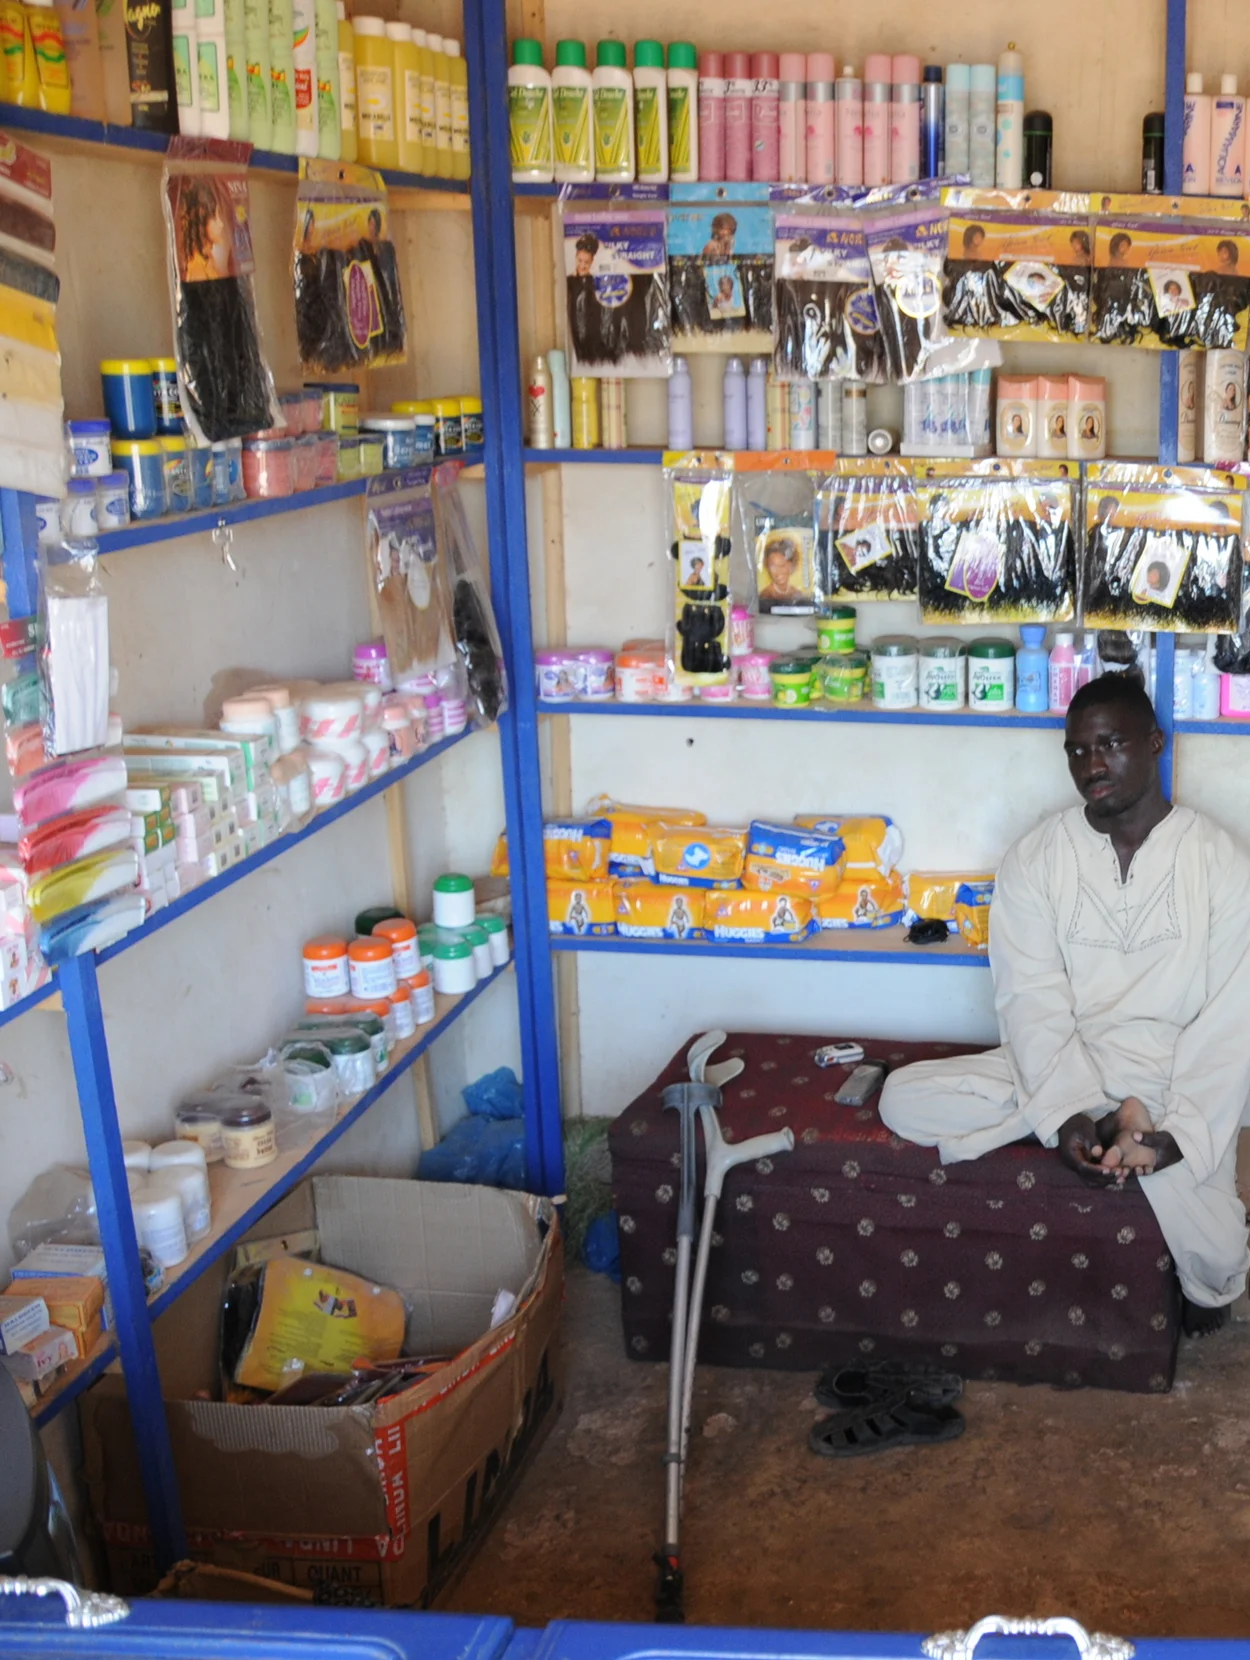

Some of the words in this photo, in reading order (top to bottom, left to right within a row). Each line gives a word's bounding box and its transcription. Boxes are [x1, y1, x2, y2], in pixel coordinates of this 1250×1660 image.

[1217, 103, 1243, 175] AQUAMARINE
[714, 925, 765, 940] HUGGIES
[307, 1565, 362, 1584] QUANT
